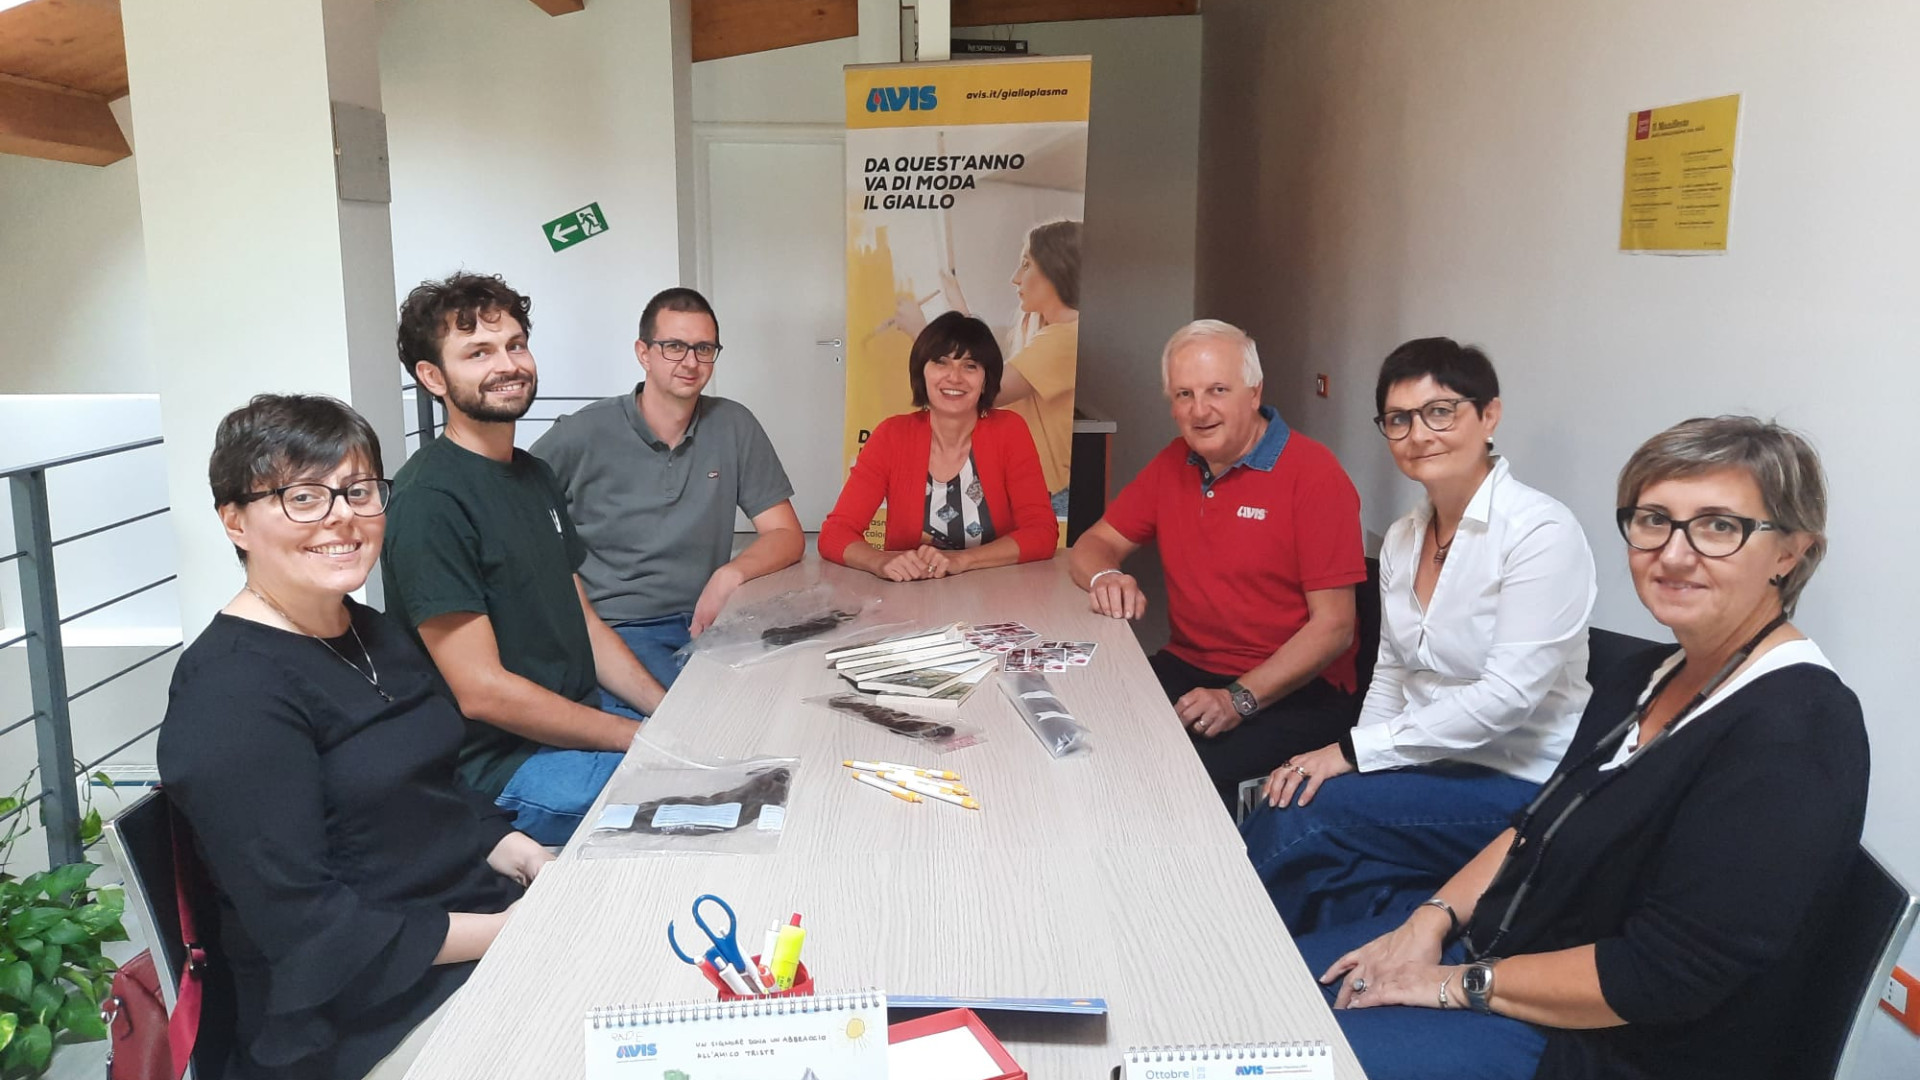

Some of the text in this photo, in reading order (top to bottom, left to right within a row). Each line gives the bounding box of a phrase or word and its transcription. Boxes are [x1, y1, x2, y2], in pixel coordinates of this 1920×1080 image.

[866, 85, 938, 113] AVIS
[966, 88, 1068, 101] avis.it/gialloplasma
[864, 154, 1025, 173] DA QUEST'ANNO
[864, 174, 976, 191] VA DI MODA
[863, 194, 955, 210] IL GIALLO
[1236, 505, 1266, 520] AVIS
[770, 1036, 780, 1044] UN
[616, 1043, 658, 1059] AVIS
[745, 1048, 775, 1057] TRISTE
[1145, 1070, 1190, 1080] Ottobre
[1235, 1065, 1264, 1076] AVIS
